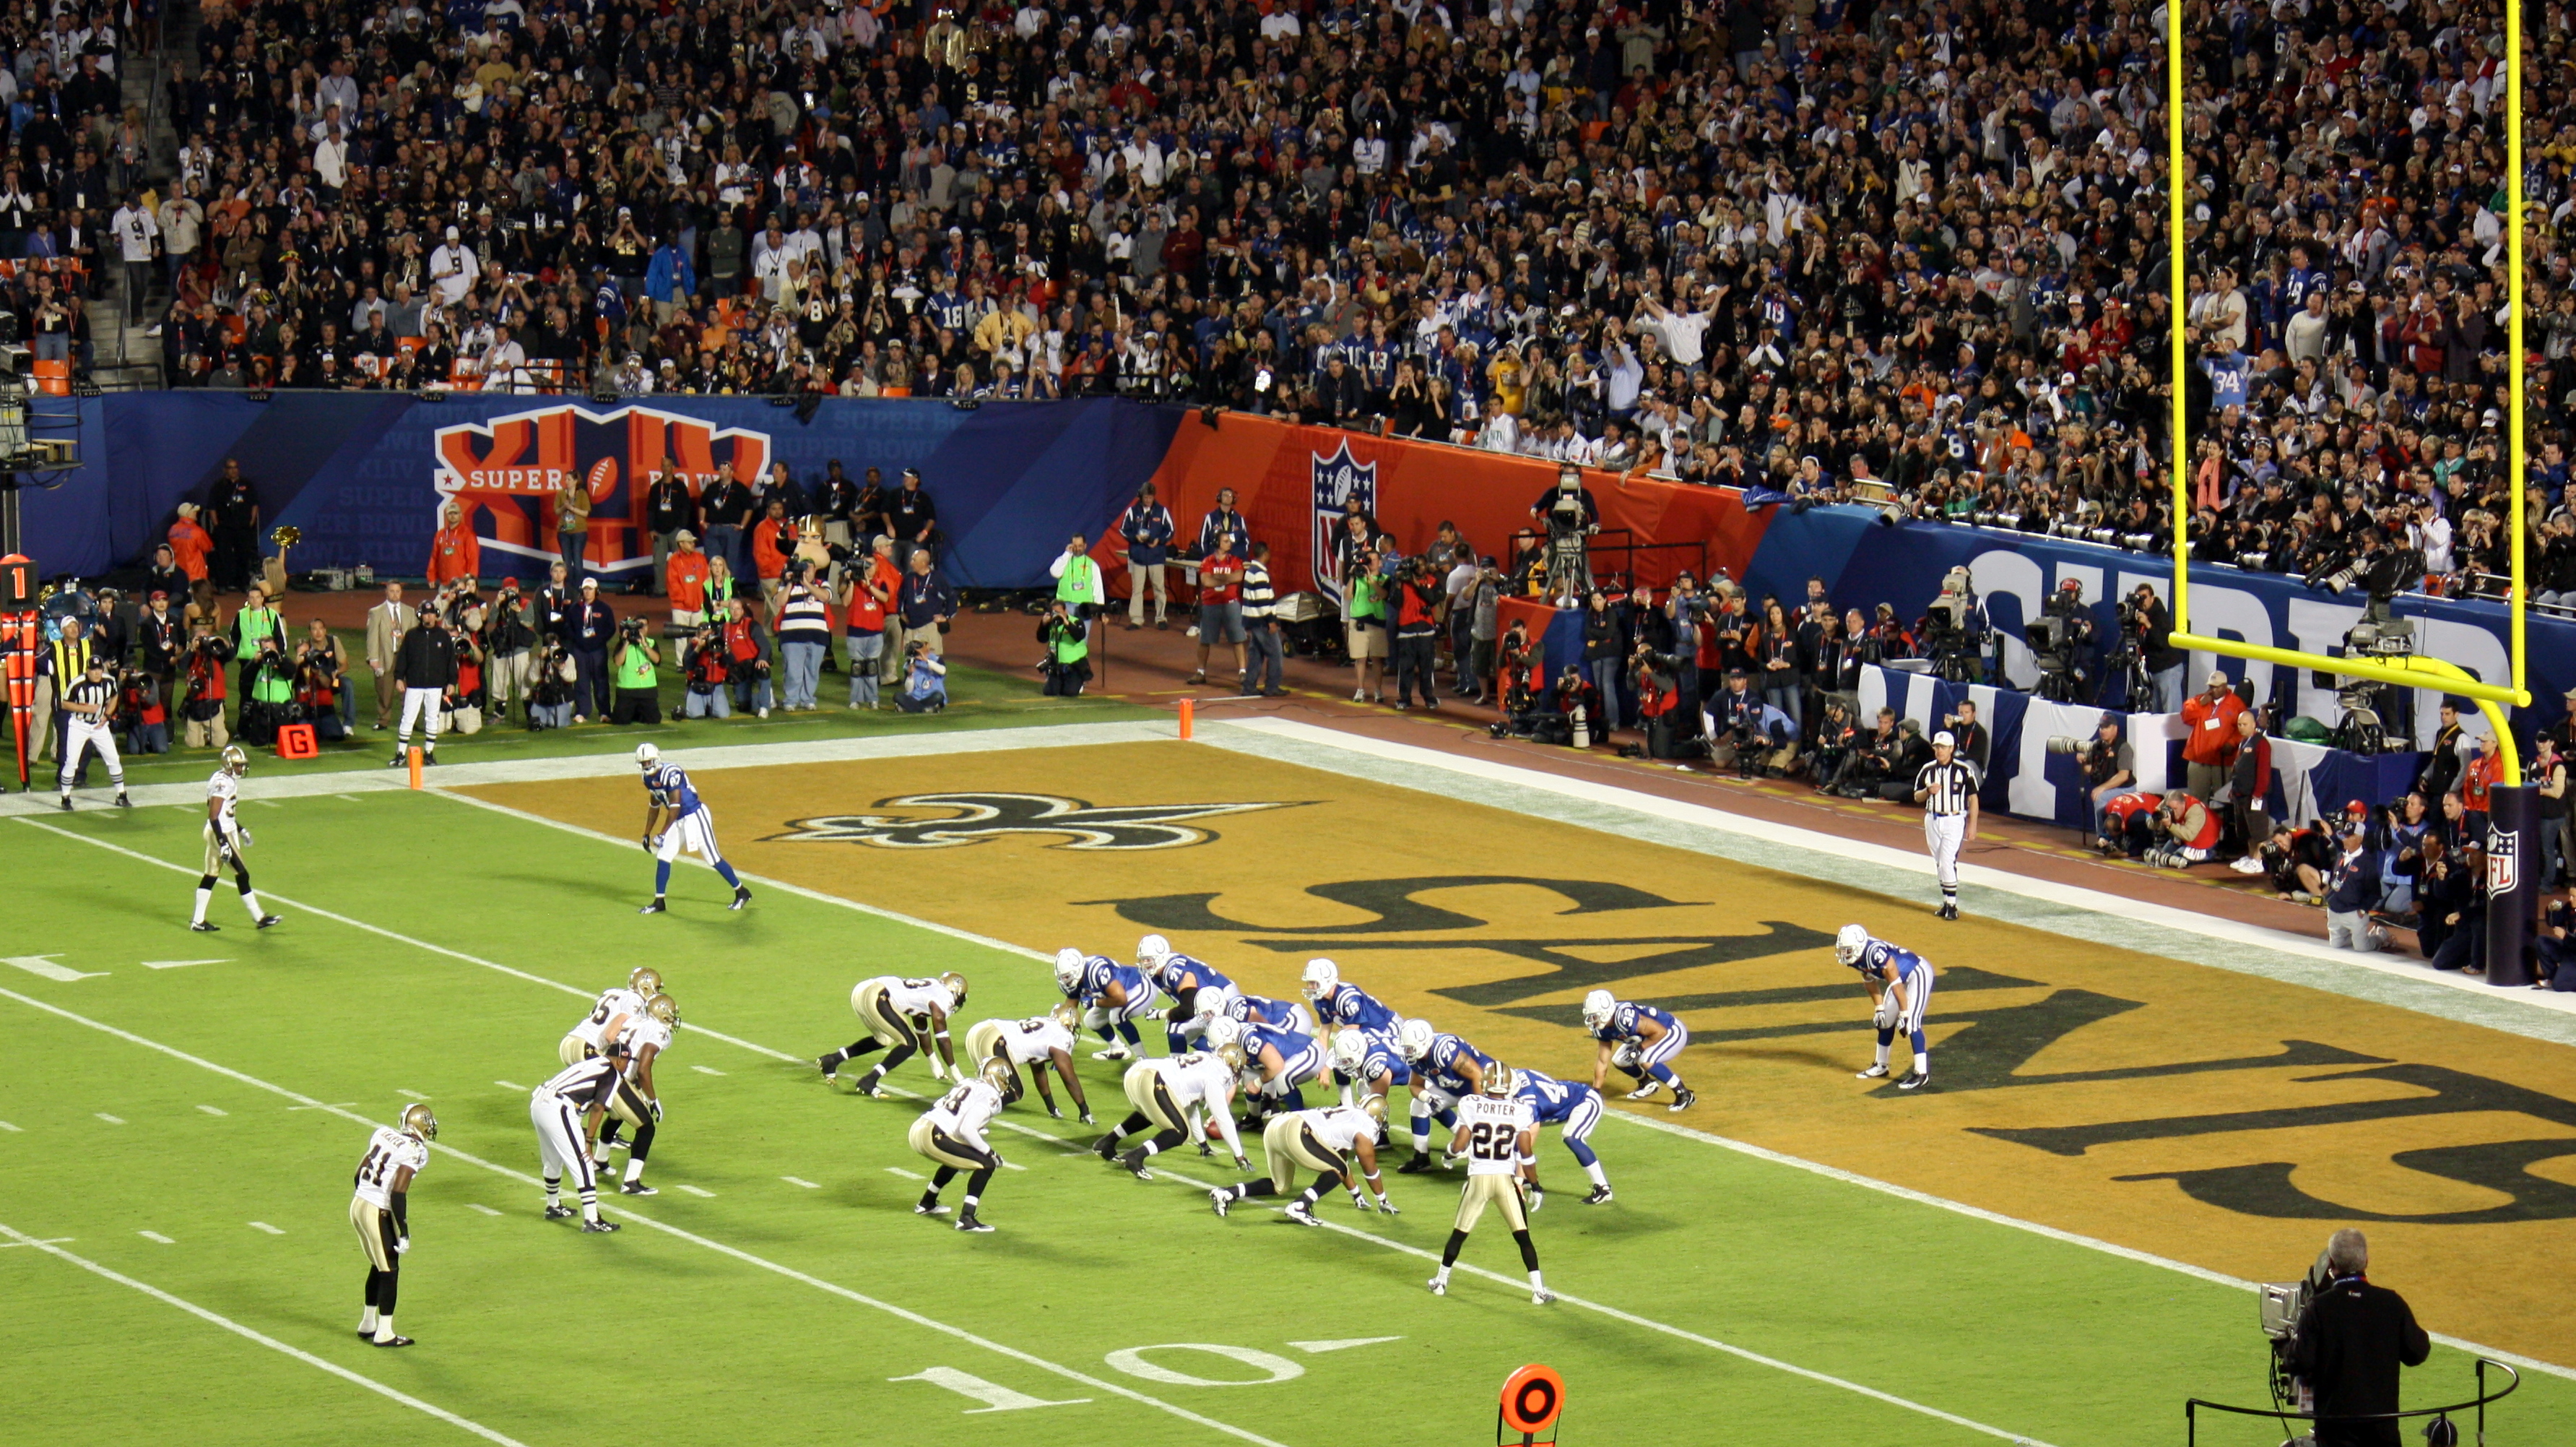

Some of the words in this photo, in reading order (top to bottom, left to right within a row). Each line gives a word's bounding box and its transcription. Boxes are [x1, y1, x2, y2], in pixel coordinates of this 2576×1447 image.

[966, 82, 979, 102] 9
[194, 160, 204, 179] 9
[131, 220, 146, 241] 9
[810, 301, 823, 322] 8
[942, 305, 963, 329] 18
[2214, 371, 2241, 394] 34
[471, 468, 563, 491] SUPER
[12, 567, 25, 599] 1
[289, 730, 308, 753] G
[1873, 948, 1888, 964] 31
[1169, 969, 1184, 982] 71
[1345, 999, 1361, 1016] 18
[1623, 1008, 1636, 1027] 32
[1247, 1035, 1263, 1055] 63
[1441, 1045, 1457, 1063] 74
[1369, 1062, 1386, 1079] 65
[1476, 1102, 1516, 1115] PORTER
[1473, 1123, 1517, 1160] 22
